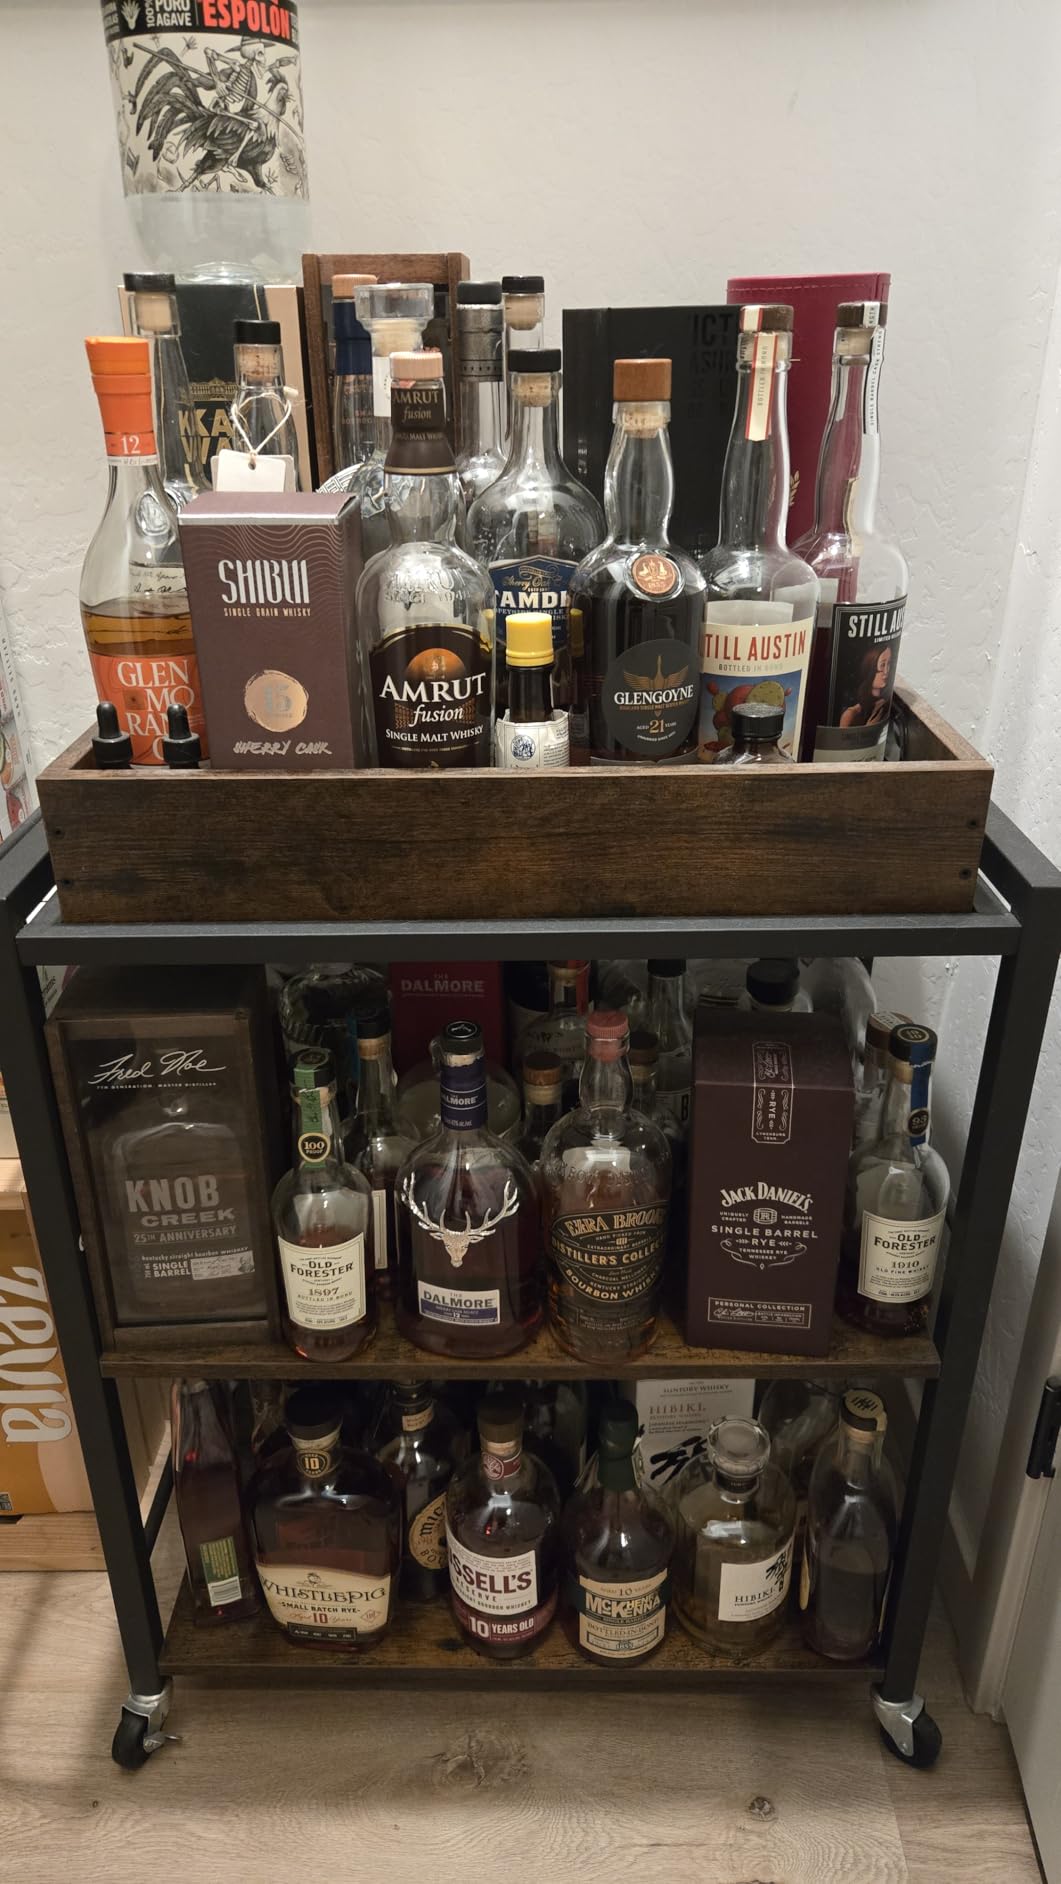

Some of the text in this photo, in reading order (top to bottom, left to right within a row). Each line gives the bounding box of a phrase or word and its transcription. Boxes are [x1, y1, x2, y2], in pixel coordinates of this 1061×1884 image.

[155, 0, 191, 12] PURO
[157, 13, 192, 26] AGAVE
[202, 0, 291, 40] ESPOLÓN
[402, 406, 433, 423] fusion
[121, 434, 142, 455] 12
[217, 559, 311, 604] SHIBUI
[495, 590, 568, 610] AMD
[224, 607, 312, 617] SINGLE GRAIN WHISKY
[847, 612, 888, 639] STILL
[703, 630, 808, 661] TILL AUSTIN
[117, 660, 190, 688] GLEN
[718, 663, 751, 673] BOTTLED
[380, 672, 487, 704] AMRUT
[613, 684, 695, 706] GLENGOYNE
[144, 685, 195, 712] MO
[408, 704, 465, 728] fusion
[385, 725, 484, 743] SINGLE MALT WHISKY
[649, 719, 666, 735] 21
[401, 979, 486, 993] DALMORE
[768, 1101, 777, 1119] RYE
[304, 1140, 326, 1151] 100
[125, 1174, 221, 1213] KNOB
[720, 1181, 814, 1212] JACK DANIEL'S
[141, 1207, 236, 1228] CREEK
[159, 1225, 237, 1243] ANNIVERSARY
[711, 1224, 819, 1239] SINGLE BARREL
[897, 1233, 921, 1243] OLD
[751, 1238, 777, 1248] RYE
[873, 1234, 937, 1252] FORESTER
[152, 1260, 189, 1271] SINGLE
[154, 1268, 192, 1279] BARREL
[290, 1261, 354, 1279] FORESTER
[308, 1260, 333, 1270] OLD
[309, 1286, 341, 1298] 1897
[565, 1268, 619, 1300] BOURBON
[423, 1290, 496, 1309] DALMORE
[714, 1300, 806, 1312] PERSONAL COLLECTION
[304, 1457, 321, 1470] 10
[450, 1552, 533, 1595] SSELL'S
[618, 1587, 634, 1597] 10
[280, 1601, 358, 1614] SMALL BATCH RYE
[313, 1612, 330, 1625] 10
[469, 1615, 534, 1639] 10 YEARS OLD
